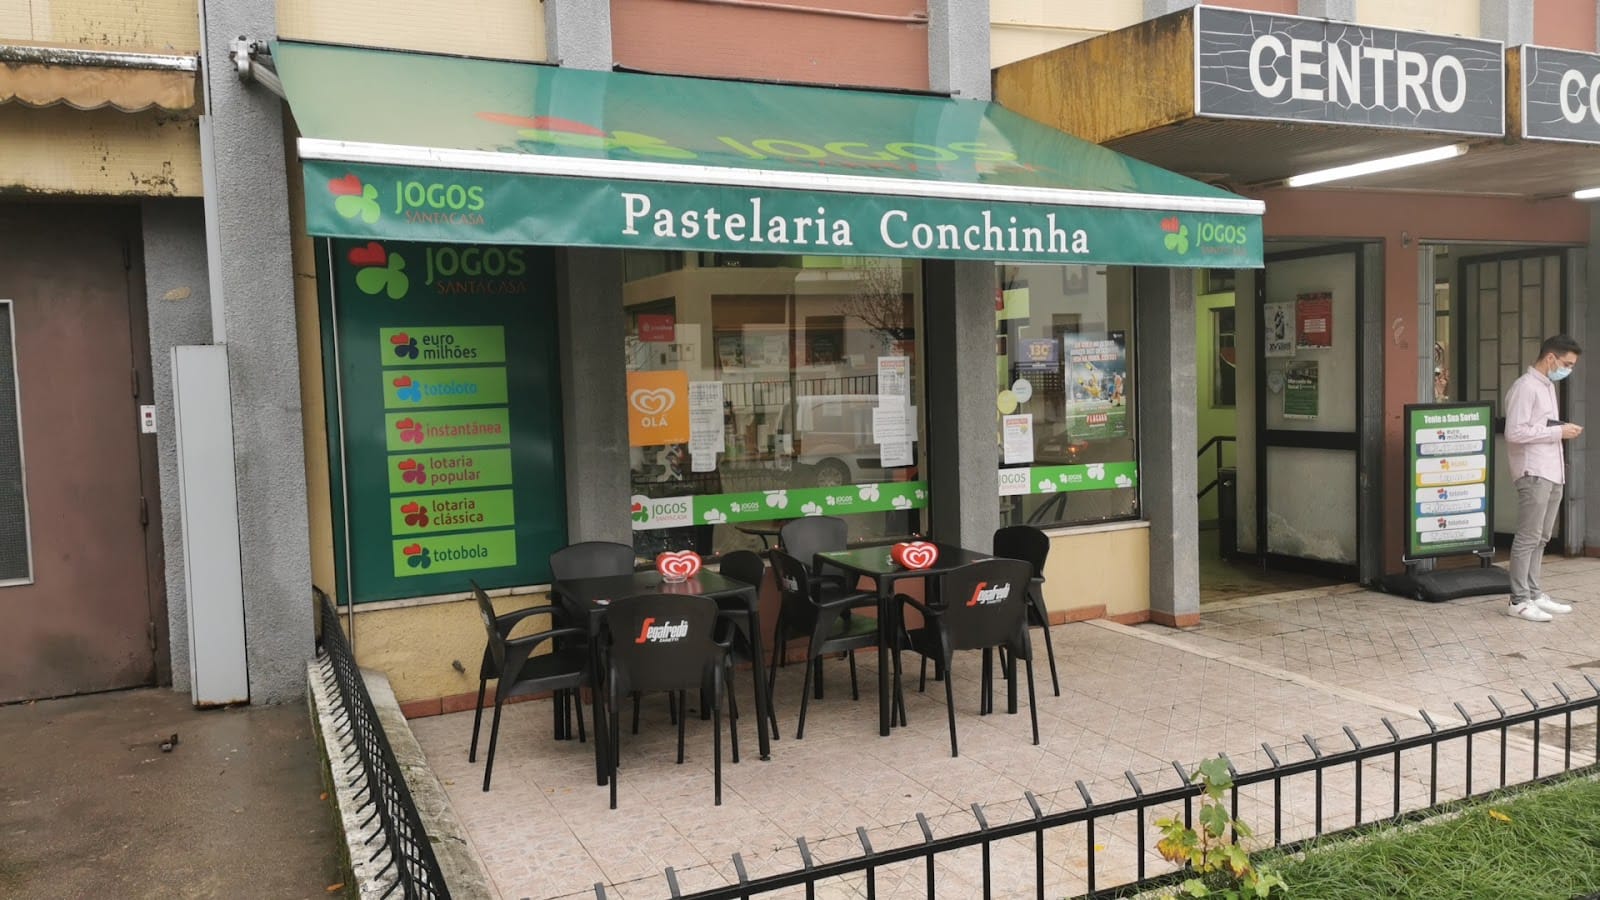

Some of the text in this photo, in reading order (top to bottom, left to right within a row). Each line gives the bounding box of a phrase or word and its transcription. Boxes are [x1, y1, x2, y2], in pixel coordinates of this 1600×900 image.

[1249, 33, 1467, 114] CENTRO
[717, 136, 1018, 161] JOGOS
[395, 180, 486, 214] JOGOS
[405, 210, 486, 226] SANTACASA
[621, 192, 1090, 255] Pastelaria Conchinha
[1195, 221, 1248, 248] JOGOS
[424, 246, 527, 286] JOGOS
[423, 333, 455, 347] euro
[423, 344, 478, 360] milhões
[424, 382, 478, 396] totoloto
[426, 421, 503, 437] instantânea
[641, 414, 668, 428] OLÁ
[430, 456, 474, 469] lotaria
[431, 469, 481, 487] popular
[432, 497, 476, 512] lotaria
[652, 502, 687, 519] JOGOS
[433, 511, 485, 527] clássica
[433, 545, 489, 562] totobola
[635, 617, 689, 644] Segafredo
